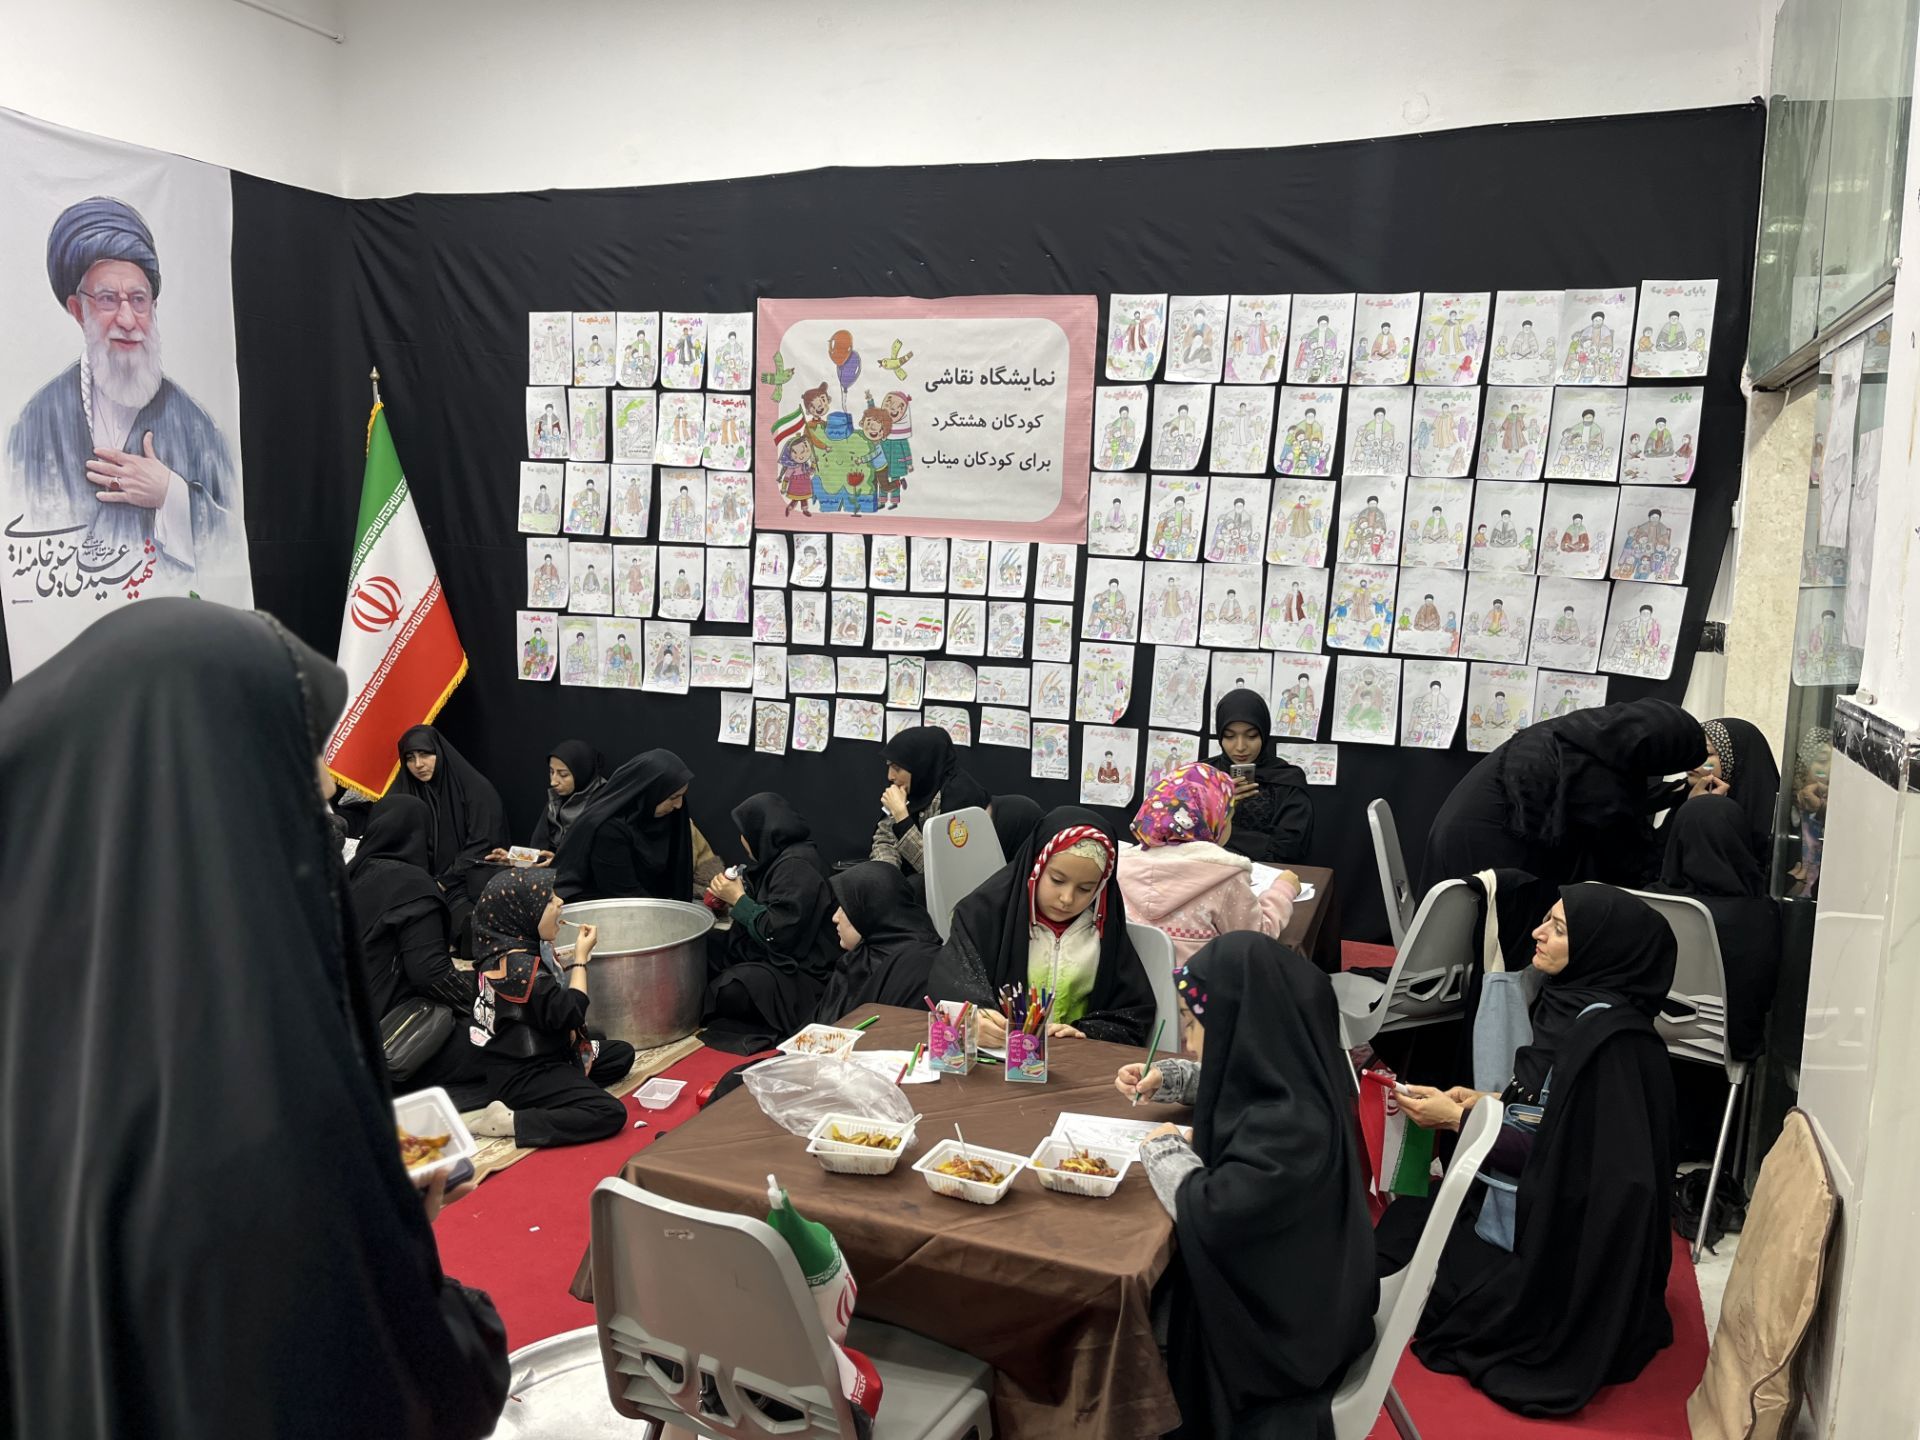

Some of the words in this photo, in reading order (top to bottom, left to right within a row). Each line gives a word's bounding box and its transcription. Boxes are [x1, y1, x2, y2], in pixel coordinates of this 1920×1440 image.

[925, 367, 973, 392] نقاشی
[980, 366, 1055, 391] نمایشگاه
[932, 411, 987, 431] هشتگرد
[992, 413, 1044, 433] کودکان
[921, 450, 959, 469] میناب
[964, 451, 1016, 471] کودکان
[1019, 452, 1051, 472] برای
[122, 537, 157, 600] شهید
[83, 560, 143, 601] سید
